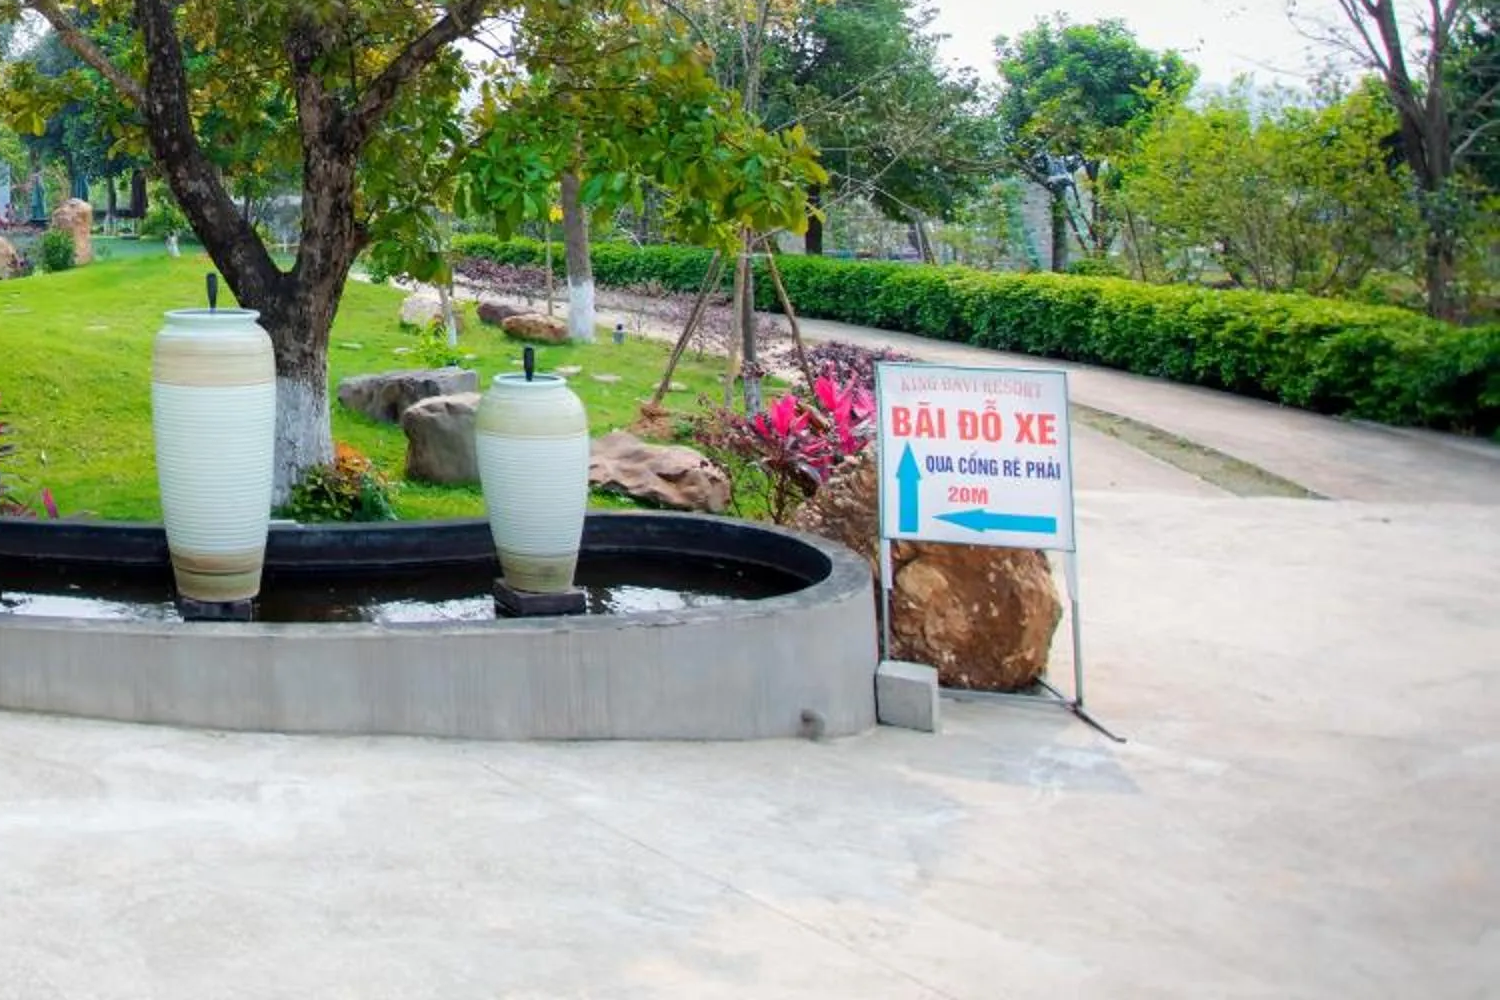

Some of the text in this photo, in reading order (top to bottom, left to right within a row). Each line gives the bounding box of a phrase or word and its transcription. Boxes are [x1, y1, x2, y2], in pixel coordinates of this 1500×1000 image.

[891, 399, 1058, 445] BÃI ĐỖ XE
[925, 455, 954, 473] QUA
[947, 486, 989, 505] 20M
